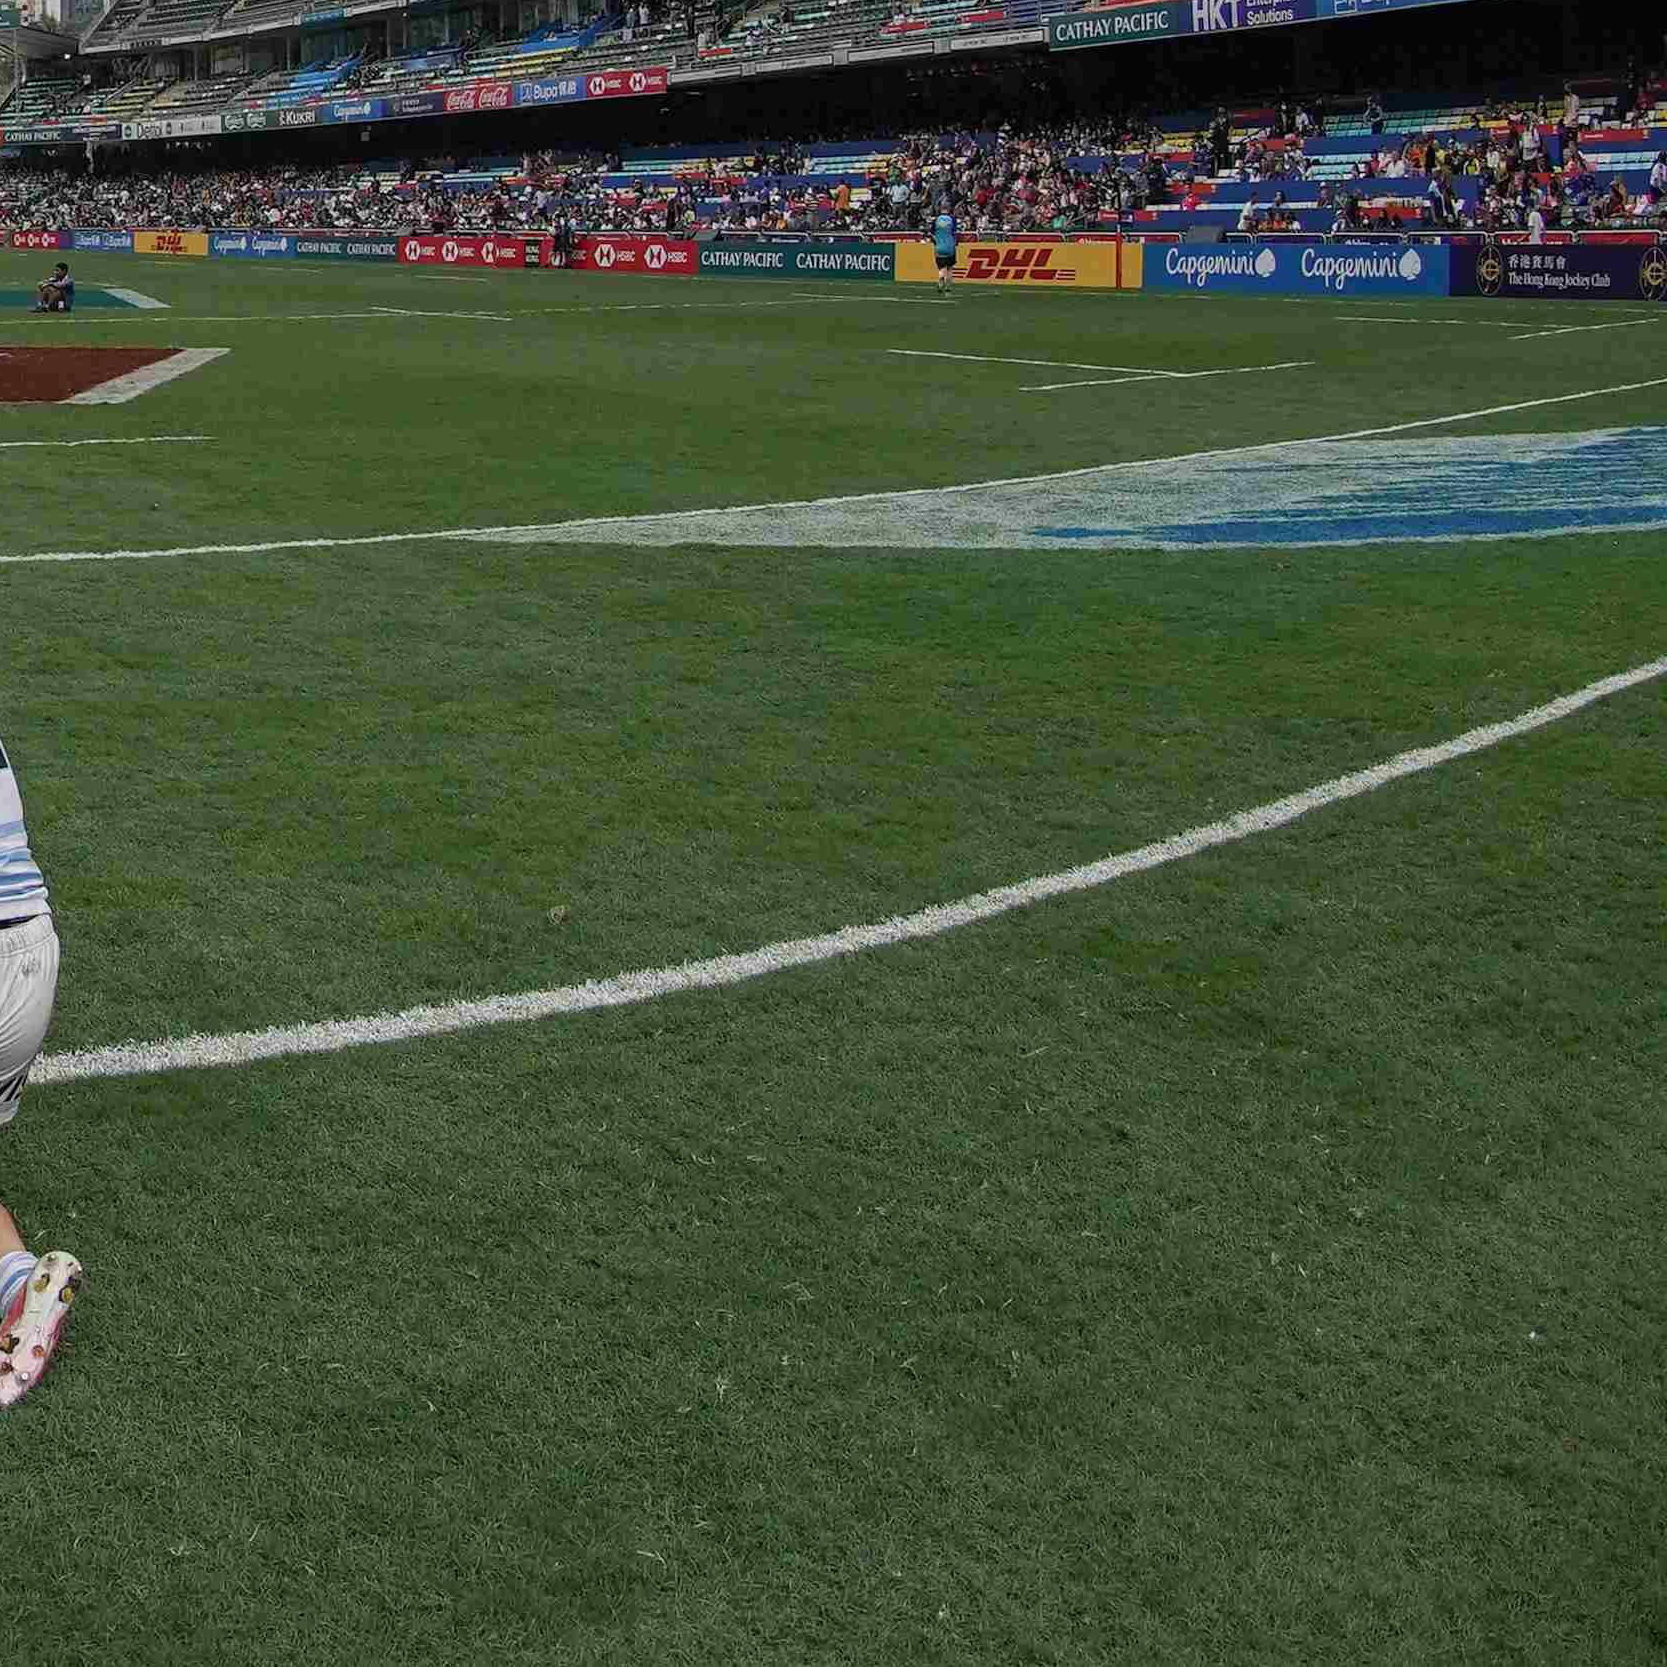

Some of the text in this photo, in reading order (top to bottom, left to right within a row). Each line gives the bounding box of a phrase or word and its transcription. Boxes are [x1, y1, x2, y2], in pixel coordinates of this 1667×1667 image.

[1055, 10, 1169, 41] CATHAY PACIFIC
[1246, 7, 1294, 25] Solutions
[534, 84, 558, 101] Bupa
[285, 111, 316, 126] KUKRI
[616, 249, 636, 263] HSBC
[667, 250, 688, 264] HSBC
[701, 250, 784, 270] CATHAY PACIFIC
[796, 249, 891, 272] CATHAY PACIFIC
[967, 248, 1058, 280] DHL
[1166, 247, 1254, 287] Capgemini
[1301, 247, 1398, 290] Capgemini
[1508, 272, 1611, 290] The Hong Kong Jockey Club
